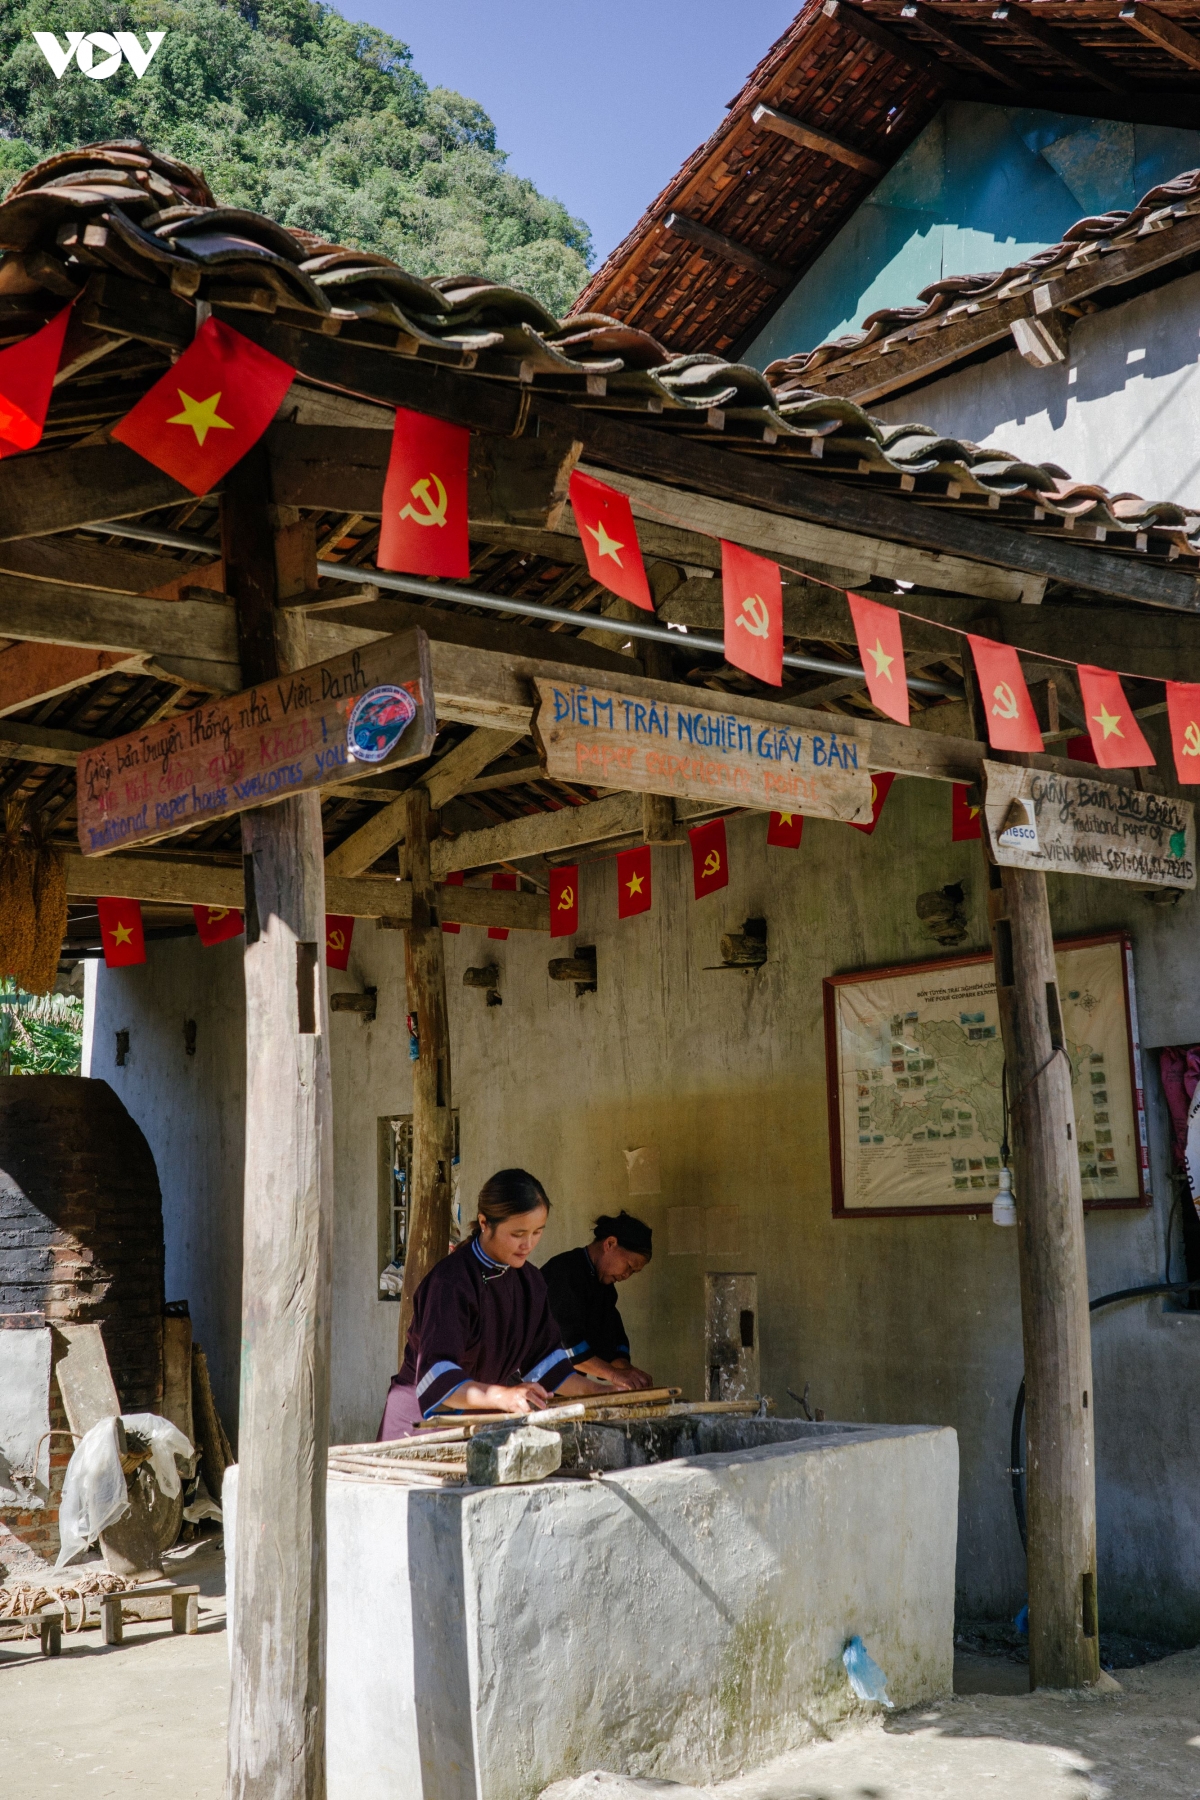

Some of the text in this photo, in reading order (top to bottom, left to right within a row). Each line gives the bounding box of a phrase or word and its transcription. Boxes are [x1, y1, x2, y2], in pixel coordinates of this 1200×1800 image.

[239, 689, 272, 728] nhà
[552, 684, 614, 730] ĐIỂM
[677, 711, 752, 754] NGHIỆM
[757, 725, 802, 763] GIẤY
[813, 732, 859, 770] BẢN
[576, 741, 821, 802] paper experience point
[1002, 827, 1036, 839] nesco
